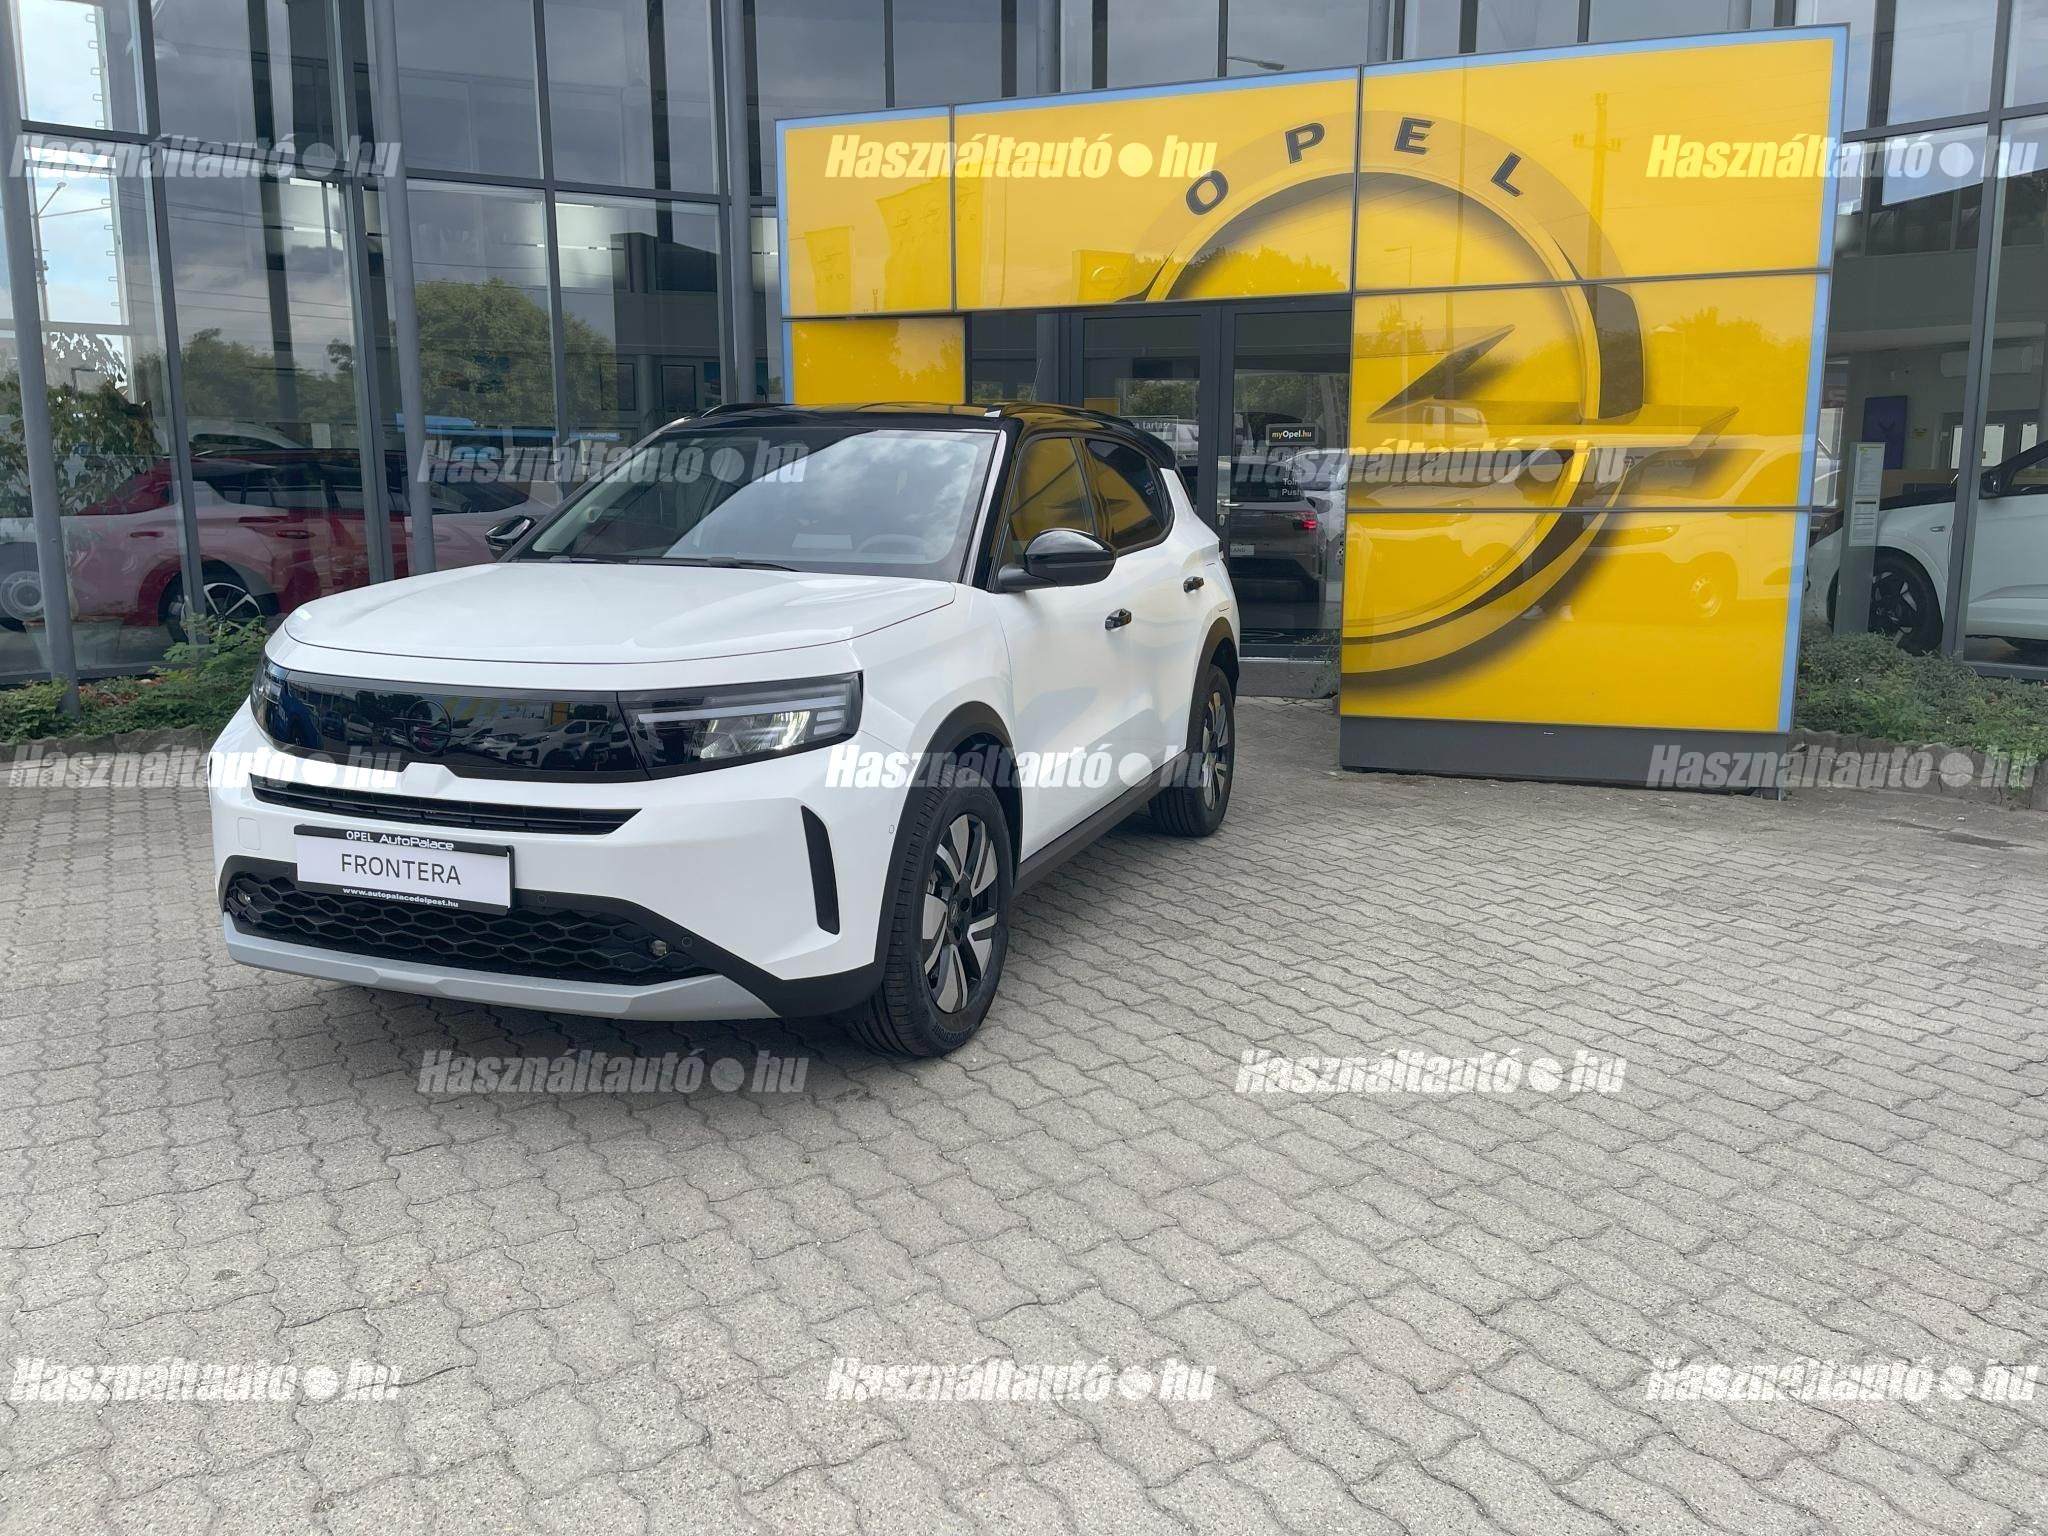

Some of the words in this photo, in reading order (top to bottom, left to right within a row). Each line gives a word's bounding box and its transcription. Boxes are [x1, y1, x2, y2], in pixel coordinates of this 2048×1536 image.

[1185, 116, 1524, 216] OPEL
[1272, 430, 1312, 439] myOpel.hu
[346, 830, 373, 842] OPEL
[379, 834, 454, 851] AutoPalace
[341, 853, 461, 885] FRONTERA
